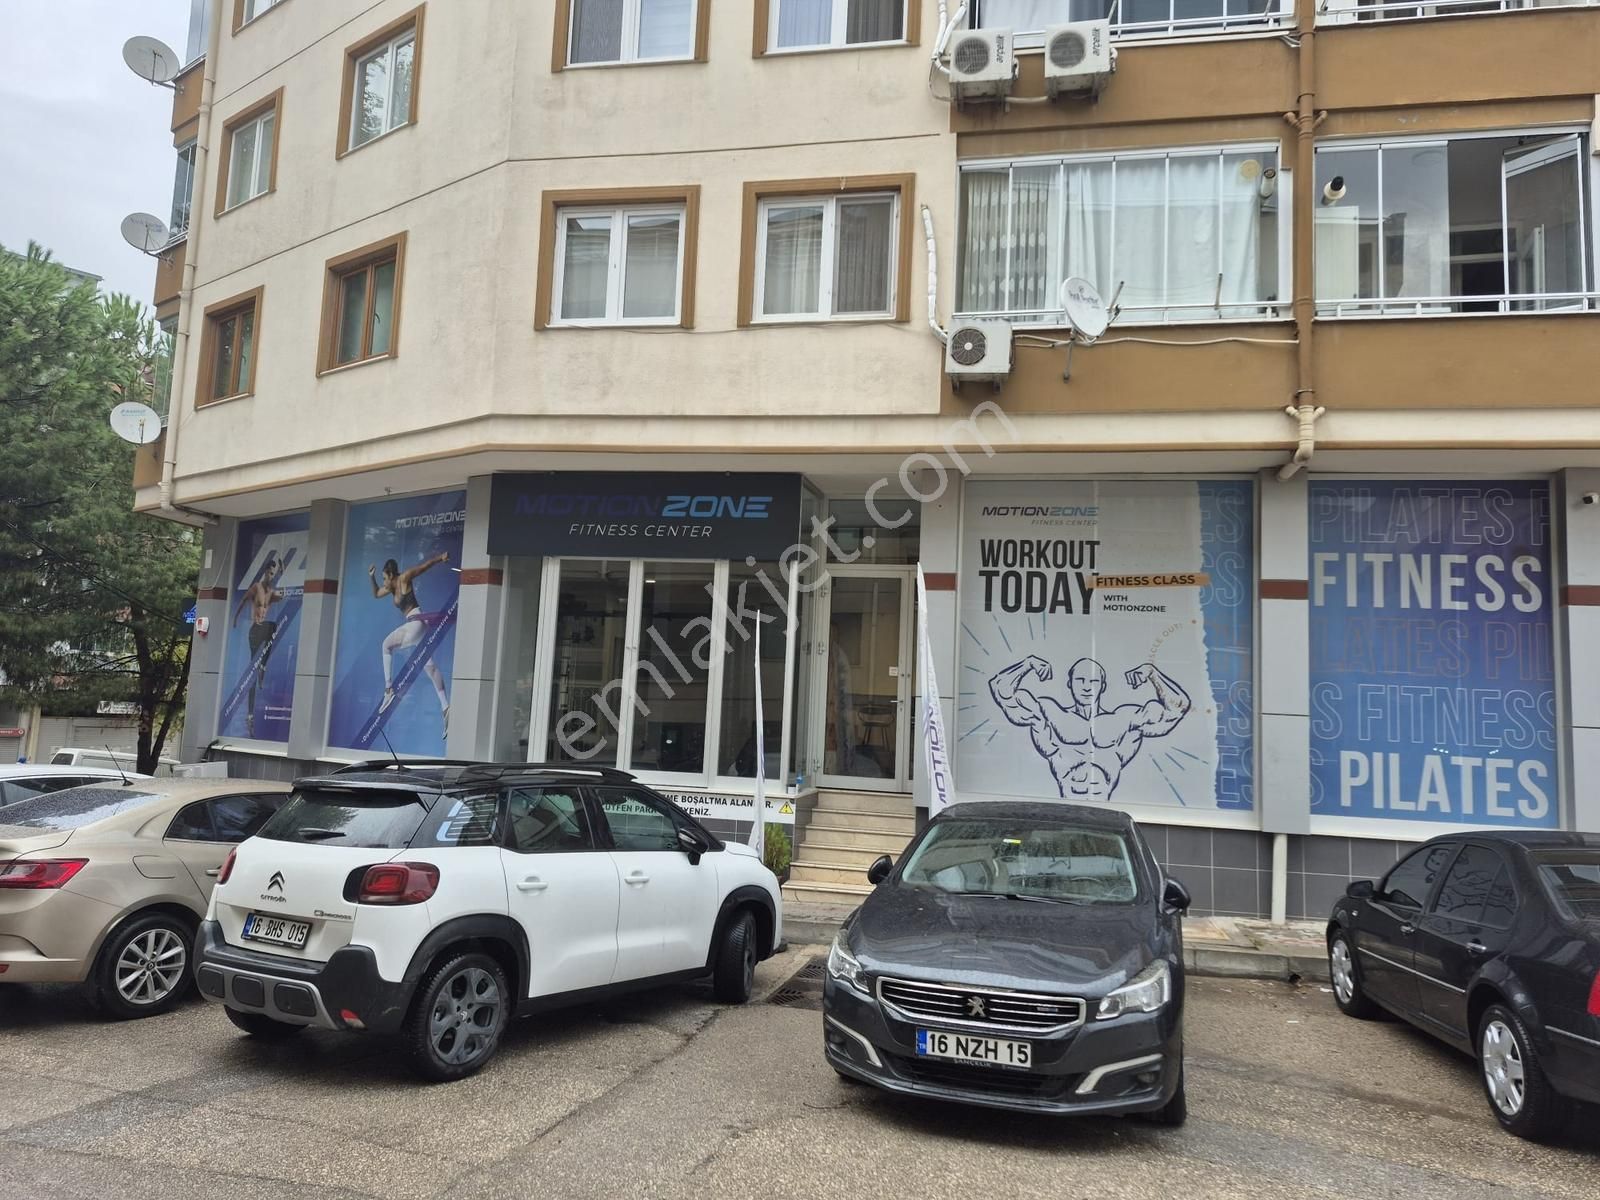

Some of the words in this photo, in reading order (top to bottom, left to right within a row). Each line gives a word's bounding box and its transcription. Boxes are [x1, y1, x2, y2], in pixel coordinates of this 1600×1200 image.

[568, 523, 638, 537] FITNESS
[644, 524, 713, 538] CENTER
[1311, 487, 1515, 545] PILATES
[980, 538, 1101, 570] WORKOUT
[978, 570, 1100, 615] TODAY
[1095, 575, 1150, 588] FITNESS
[1152, 573, 1196, 587] CLASS
[1313, 552, 1542, 613] FITNESS
[1103, 594, 1128, 603] WITH
[1103, 603, 1167, 613] MOTIONZONE
[1358, 683, 1555, 751] FITNESS
[1339, 750, 1549, 819] PILATES
[250, 916, 263, 934] 16
[265, 919, 286, 938] BHS
[287, 923, 307, 942] 015
[929, 1033, 948, 1054] 16
[955, 1036, 998, 1061] NZH
[1006, 1042, 1029, 1064] 15
